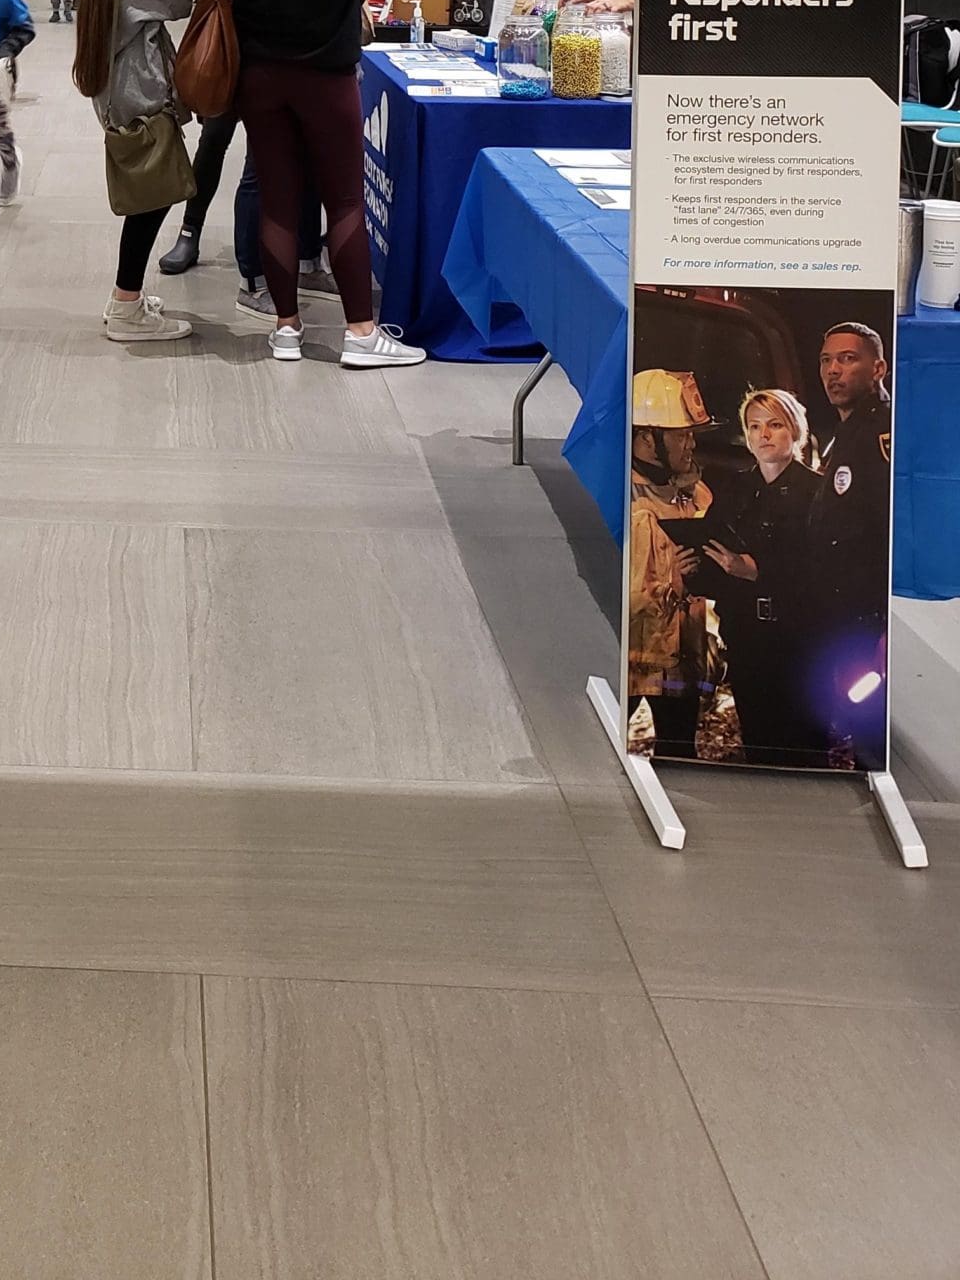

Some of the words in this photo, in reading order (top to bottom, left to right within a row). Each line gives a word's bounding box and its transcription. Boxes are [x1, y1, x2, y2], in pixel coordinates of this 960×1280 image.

[668, 12, 738, 42] first
[667, 93, 704, 108] Now
[708, 94, 762, 109] there's
[766, 98, 786, 109] an
[666, 113, 756, 129] emergency
[760, 112, 825, 127] network
[666, 127, 688, 142] for
[692, 128, 722, 143] first
[727, 129, 822, 146] responders.
[671, 153, 691, 163] The
[692, 154, 735, 164] exclusive
[737, 155, 776, 165] wireless
[777, 156, 855, 166] communications
[674, 165, 725, 176] ecosystem
[726, 165, 771, 177] designed
[772, 166, 785, 177] by
[787, 166, 805, 176] first
[807, 167, 863, 178] responders,
[674, 175, 688, 185] for
[689, 175, 707, 185] first
[709, 177, 763, 187] responders
[671, 194, 702, 205] Keeps
[703, 194, 722, 204] first
[724, 195, 778, 207] responders
[779, 195, 788, 205] in
[790, 196, 806, 205] the
[807, 196, 842, 206] service
[673, 205, 696, 214] "fast
[697, 205, 722, 215] lane"
[724, 206, 767, 217] 24/7/365,
[769, 208, 792, 217] even
[794, 207, 824, 219] during
[673, 216, 699, 225] times
[700, 216, 711, 225] of
[712, 217, 765, 228] congestion
[670, 234, 679, 243] A
[680, 234, 701, 246] long
[703, 235, 741, 245] overdue
[743, 236, 820, 247] communications
[822, 238, 862, 249] upgrade
[663, 257, 682, 268] For
[683, 260, 712, 268] more
[713, 259, 777, 271] information,
[779, 262, 800, 270] see
[801, 262, 809, 271] a
[811, 261, 839, 271] sales
[840, 263, 862, 273] rep.
